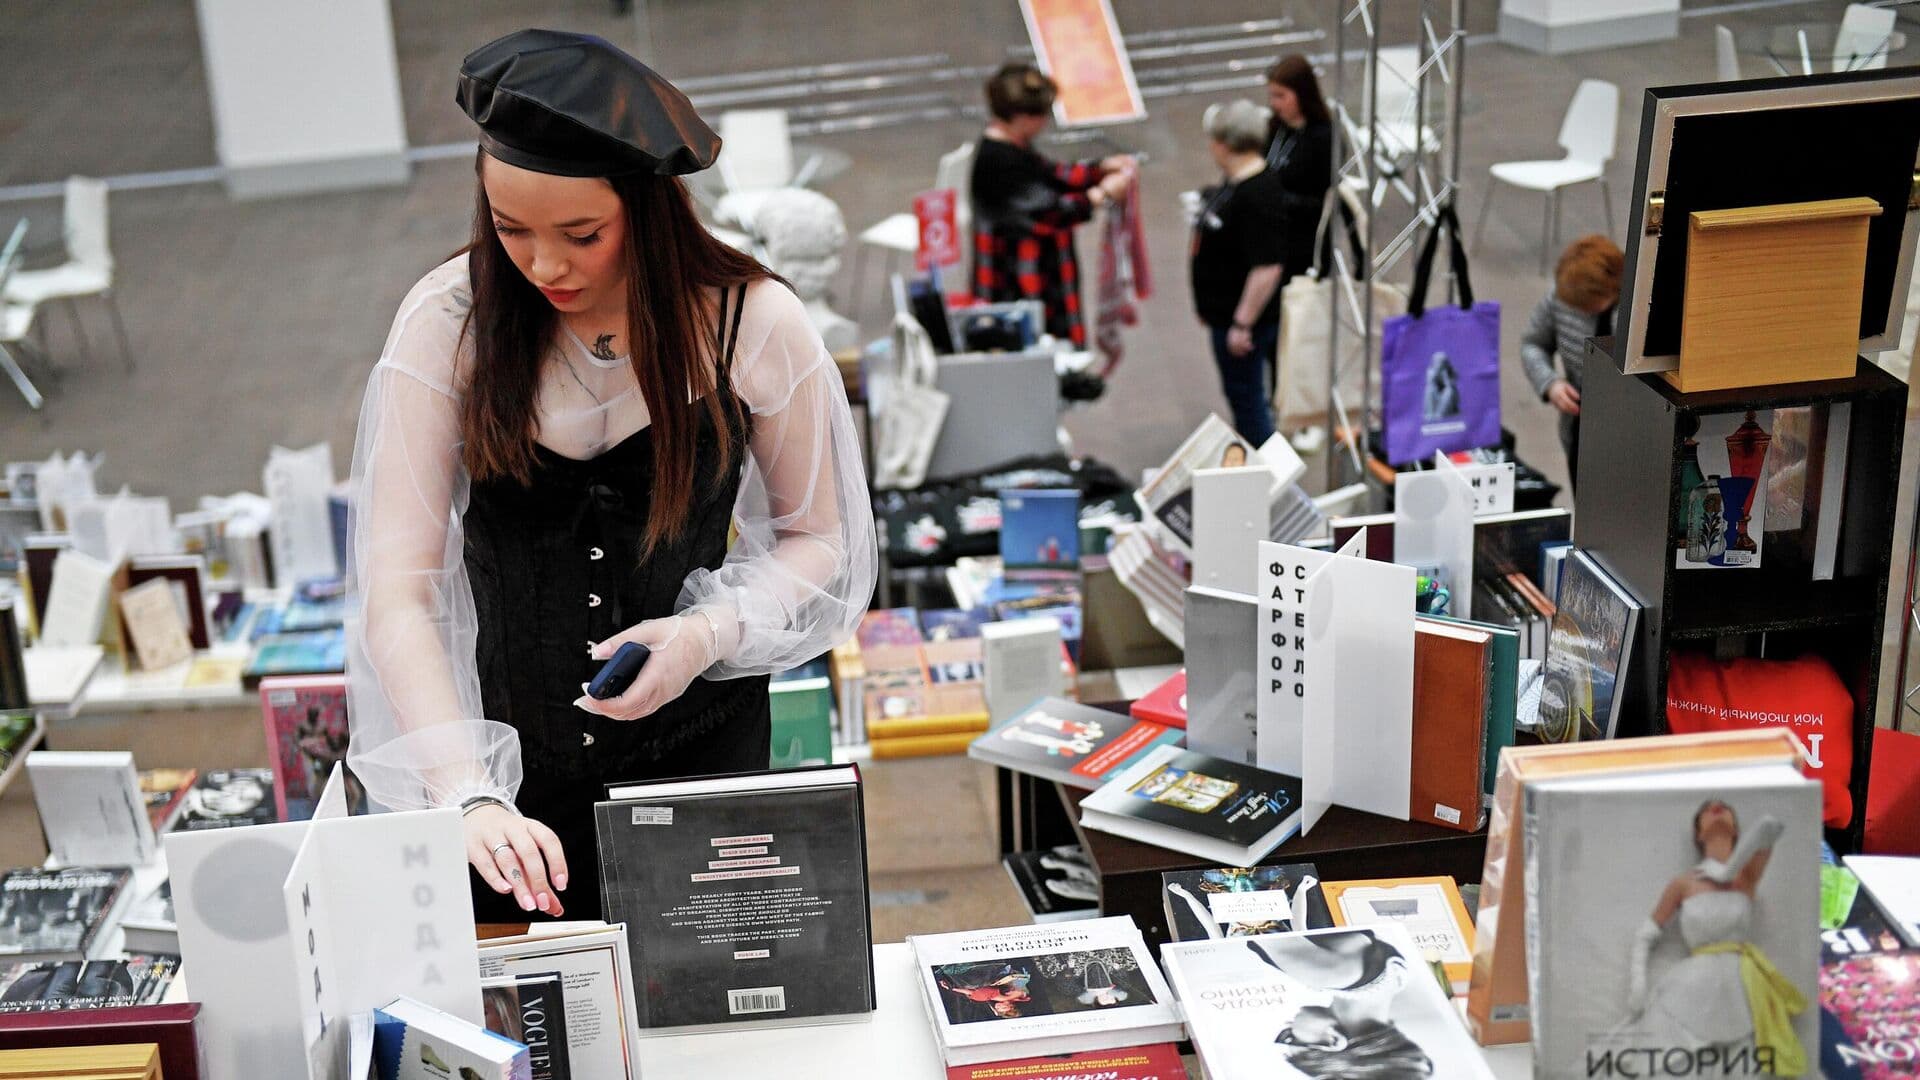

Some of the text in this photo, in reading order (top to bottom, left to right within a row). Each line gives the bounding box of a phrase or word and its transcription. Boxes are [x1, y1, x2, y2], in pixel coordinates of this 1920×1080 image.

[1269, 561, 1287, 694] ФАРФОР
[1293, 565, 1306, 697] СТЕКЛО
[1719, 709, 1791, 725] любимый
[1793, 713, 1824, 727] Мой
[402, 844, 443, 987] МОДА
[1200, 986, 1267, 1000] КИНО
[1211, 997, 1284, 1010] МОДА
[522, 996, 551, 1070] VOGUE
[1585, 1046, 1776, 1079] ИСТОРИЯ
